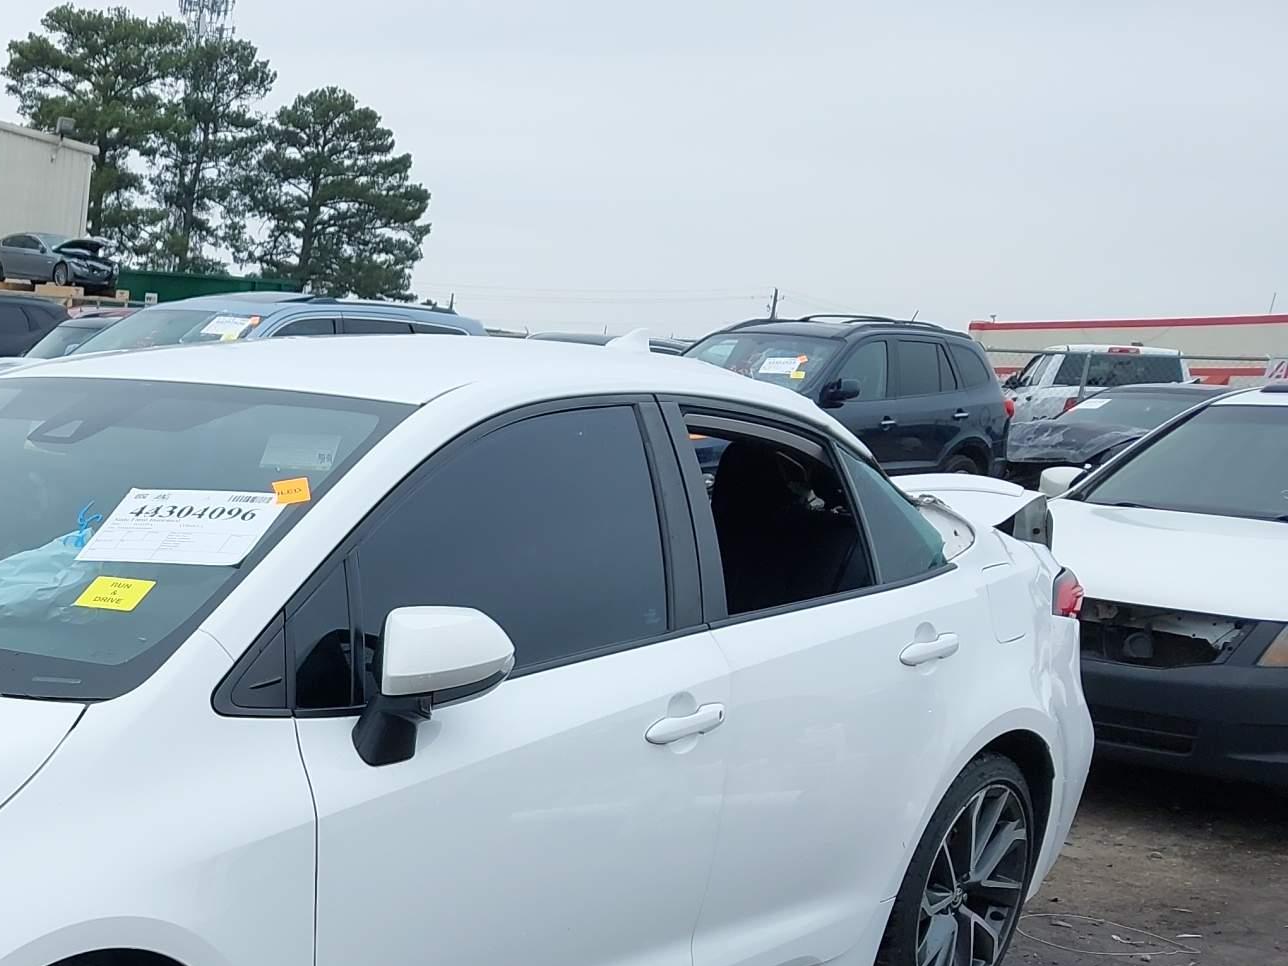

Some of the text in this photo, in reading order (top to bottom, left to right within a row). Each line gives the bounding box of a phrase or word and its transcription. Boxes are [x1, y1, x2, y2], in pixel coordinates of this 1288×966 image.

[129, 504, 260, 522] 44304096
[110, 581, 133, 589] RUN
[93, 596, 125, 605] DRIVE
